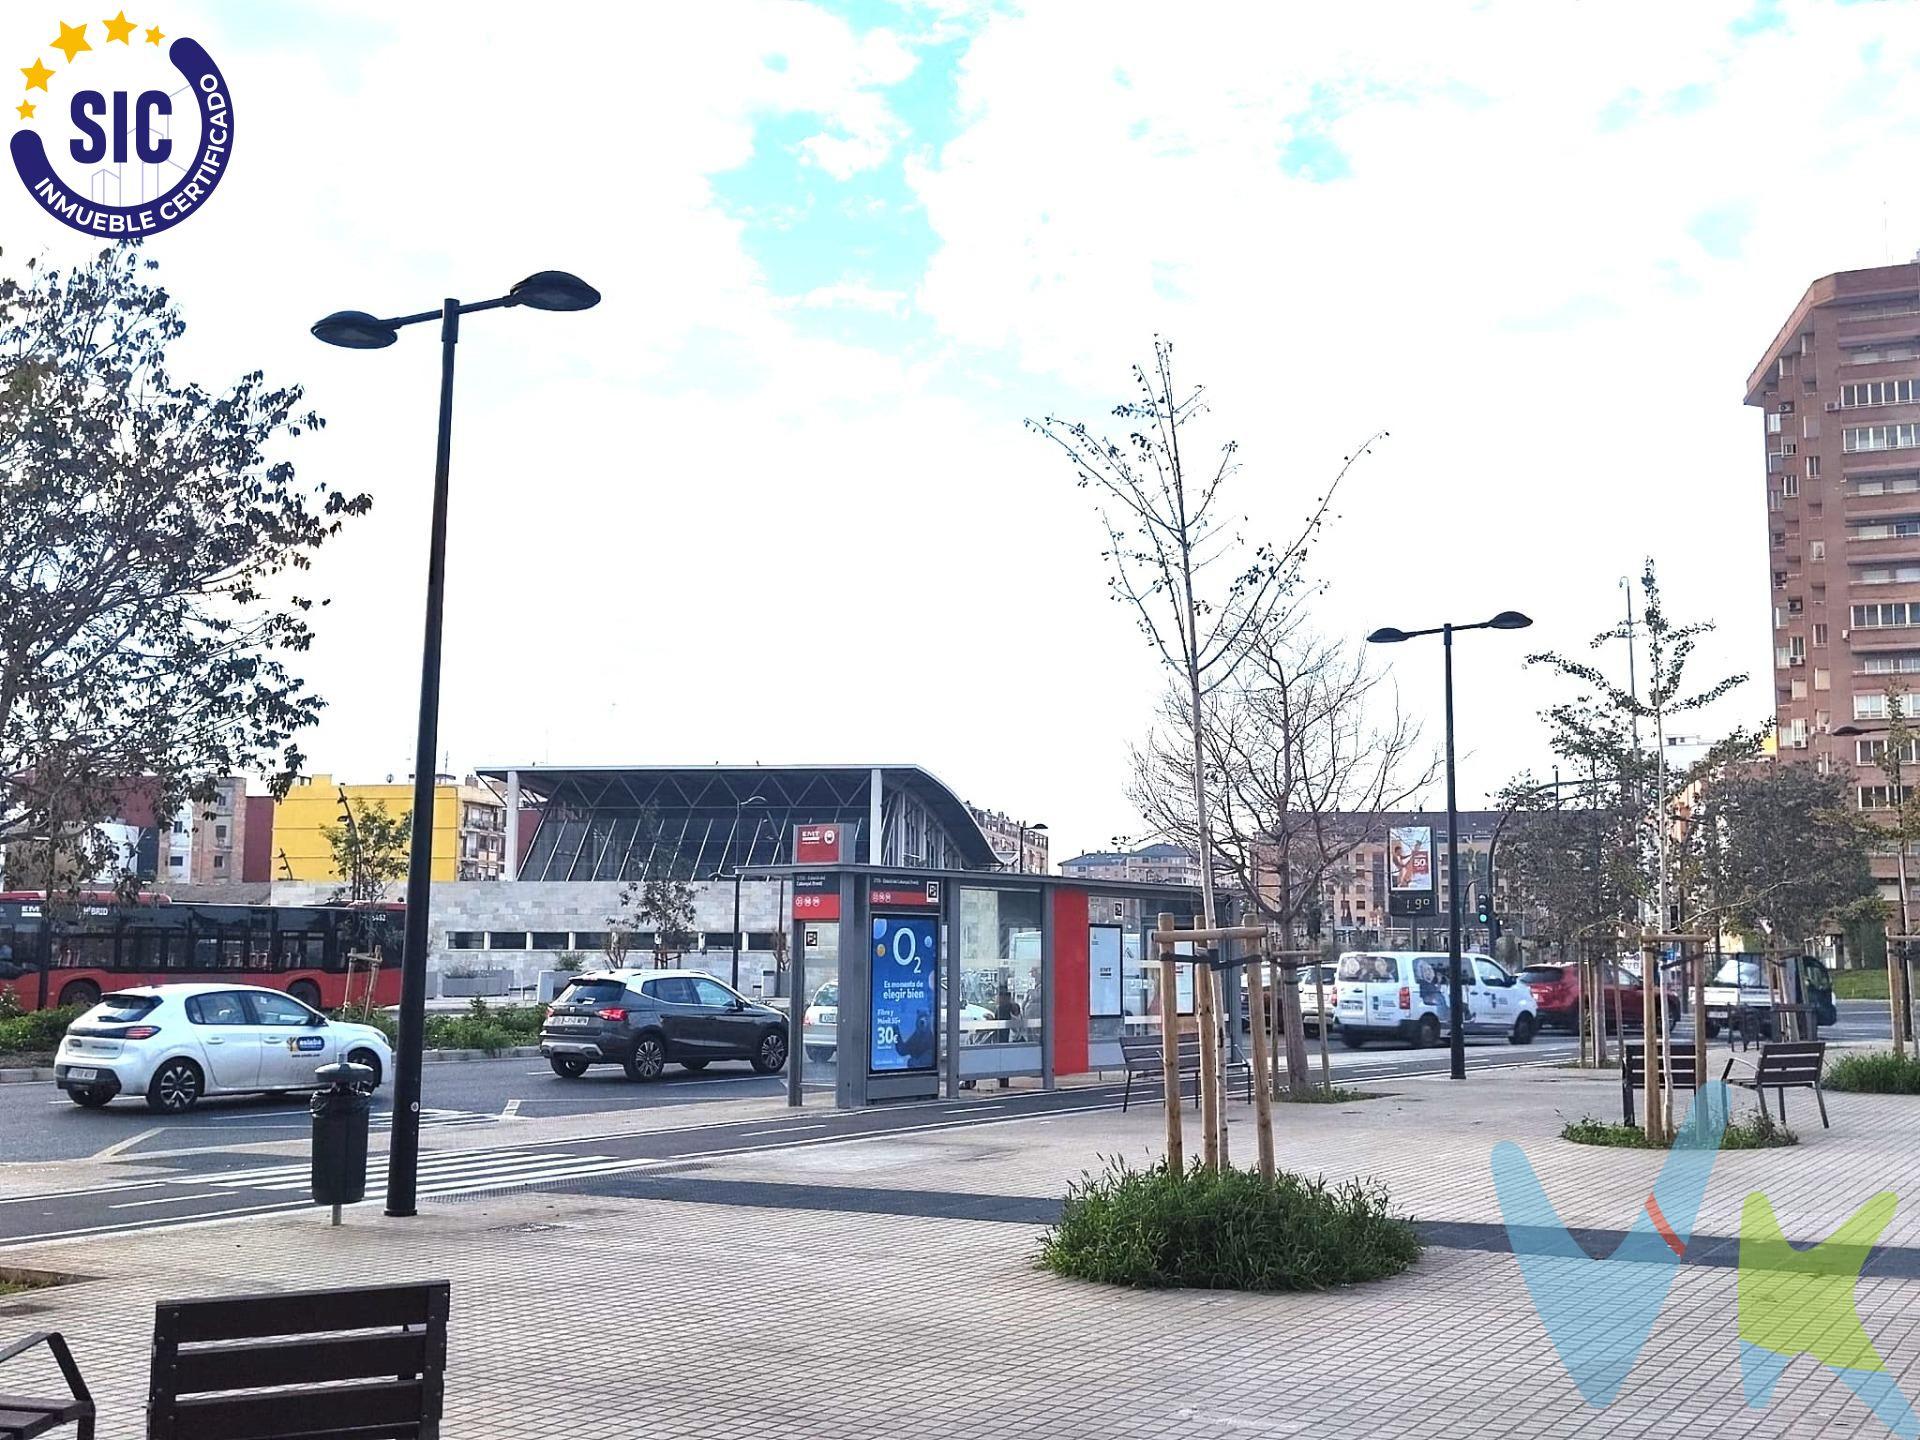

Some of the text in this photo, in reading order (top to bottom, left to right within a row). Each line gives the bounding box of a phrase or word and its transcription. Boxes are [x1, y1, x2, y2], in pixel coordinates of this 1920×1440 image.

[916, 980, 924, 988] de
[883, 988, 924, 1002] elegir bien
[877, 1026, 899, 1044] 30€
